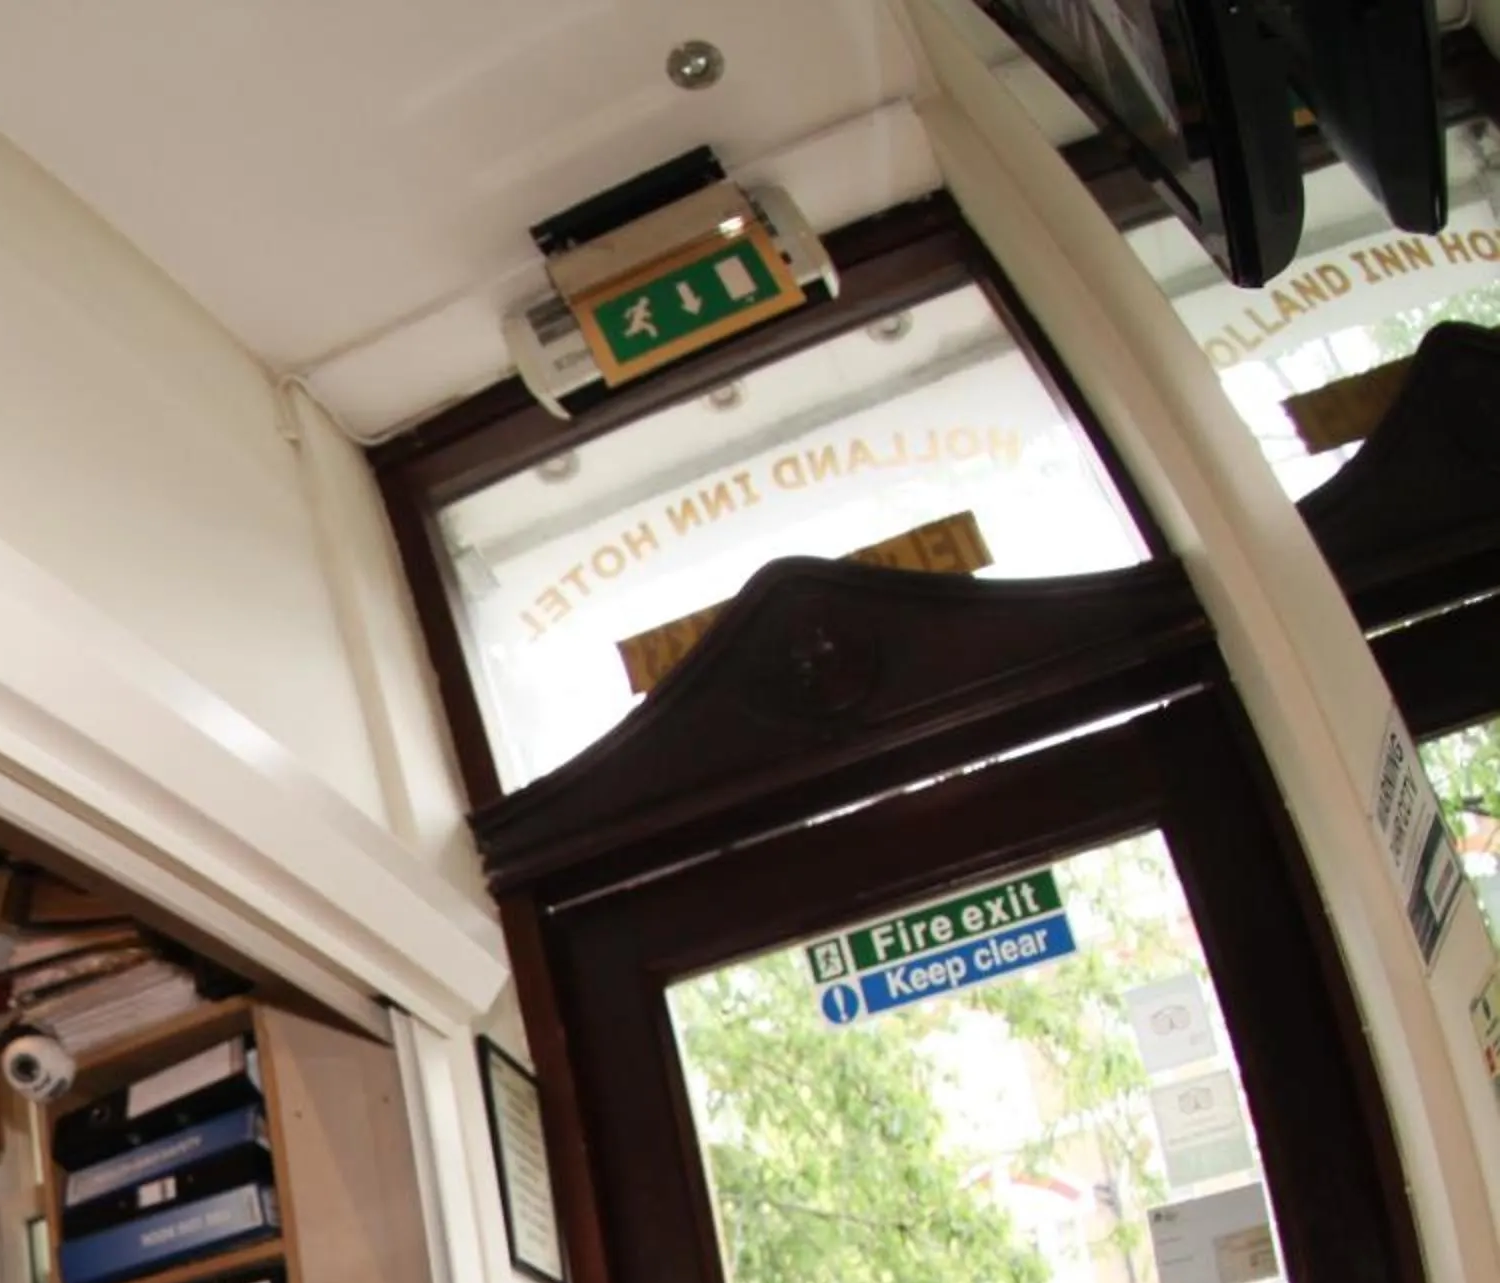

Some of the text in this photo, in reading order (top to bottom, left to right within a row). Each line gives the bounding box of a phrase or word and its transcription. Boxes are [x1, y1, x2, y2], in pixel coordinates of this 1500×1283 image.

[1203, 230, 1500, 371] OLLAND INN HO
[870, 881, 1040, 961] Fire exit
[884, 927, 1049, 1000] Keep clear
